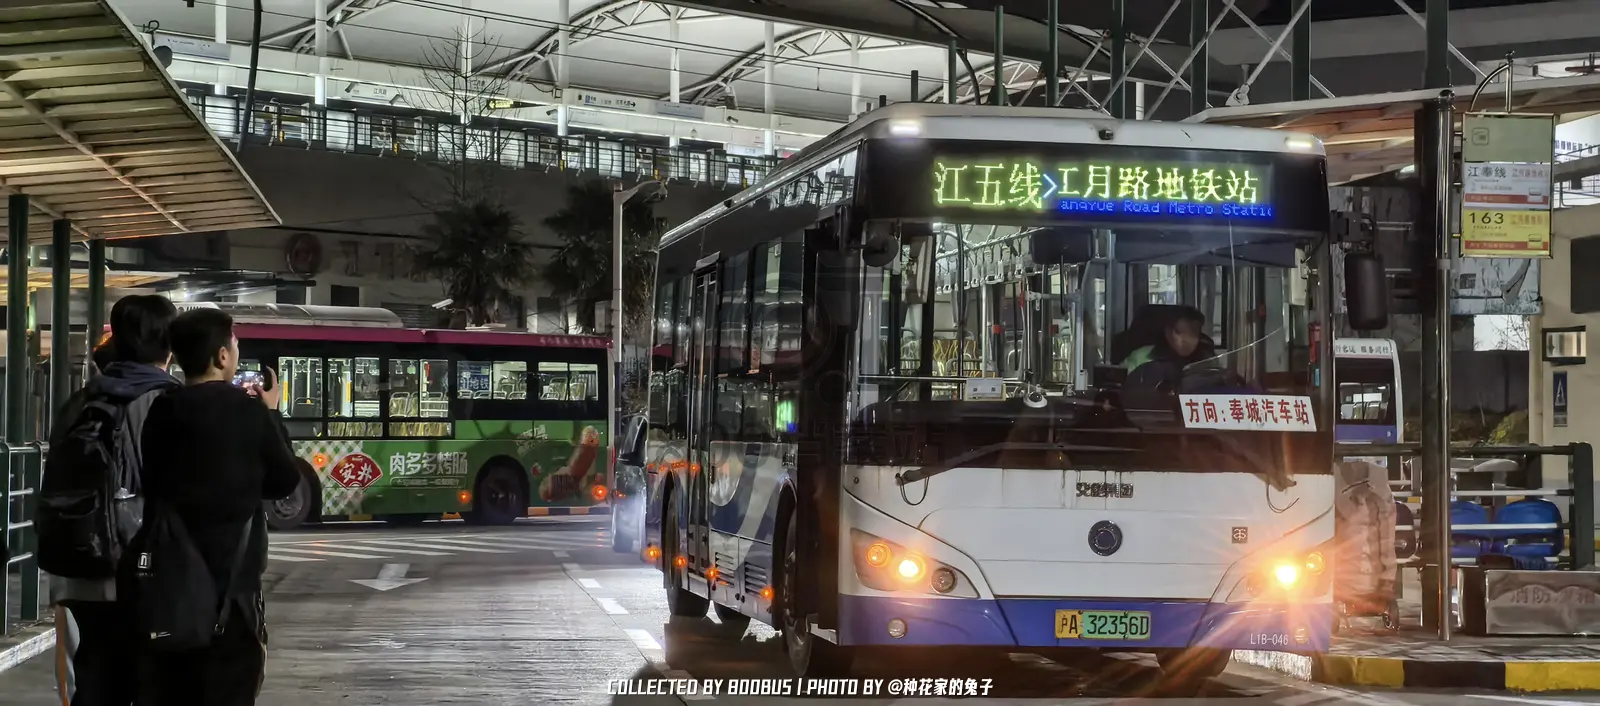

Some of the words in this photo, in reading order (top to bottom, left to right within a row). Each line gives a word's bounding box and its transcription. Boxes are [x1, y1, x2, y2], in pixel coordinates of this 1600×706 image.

[934, 162, 1043, 209] 江五线
[1124, 199, 1160, 213] Road
[1168, 200, 1214, 215] Metro
[1469, 211, 1504, 225] 163
[389, 451, 468, 476] 肉多多烤肠
[1250, 633, 1289, 646] L1B-046
